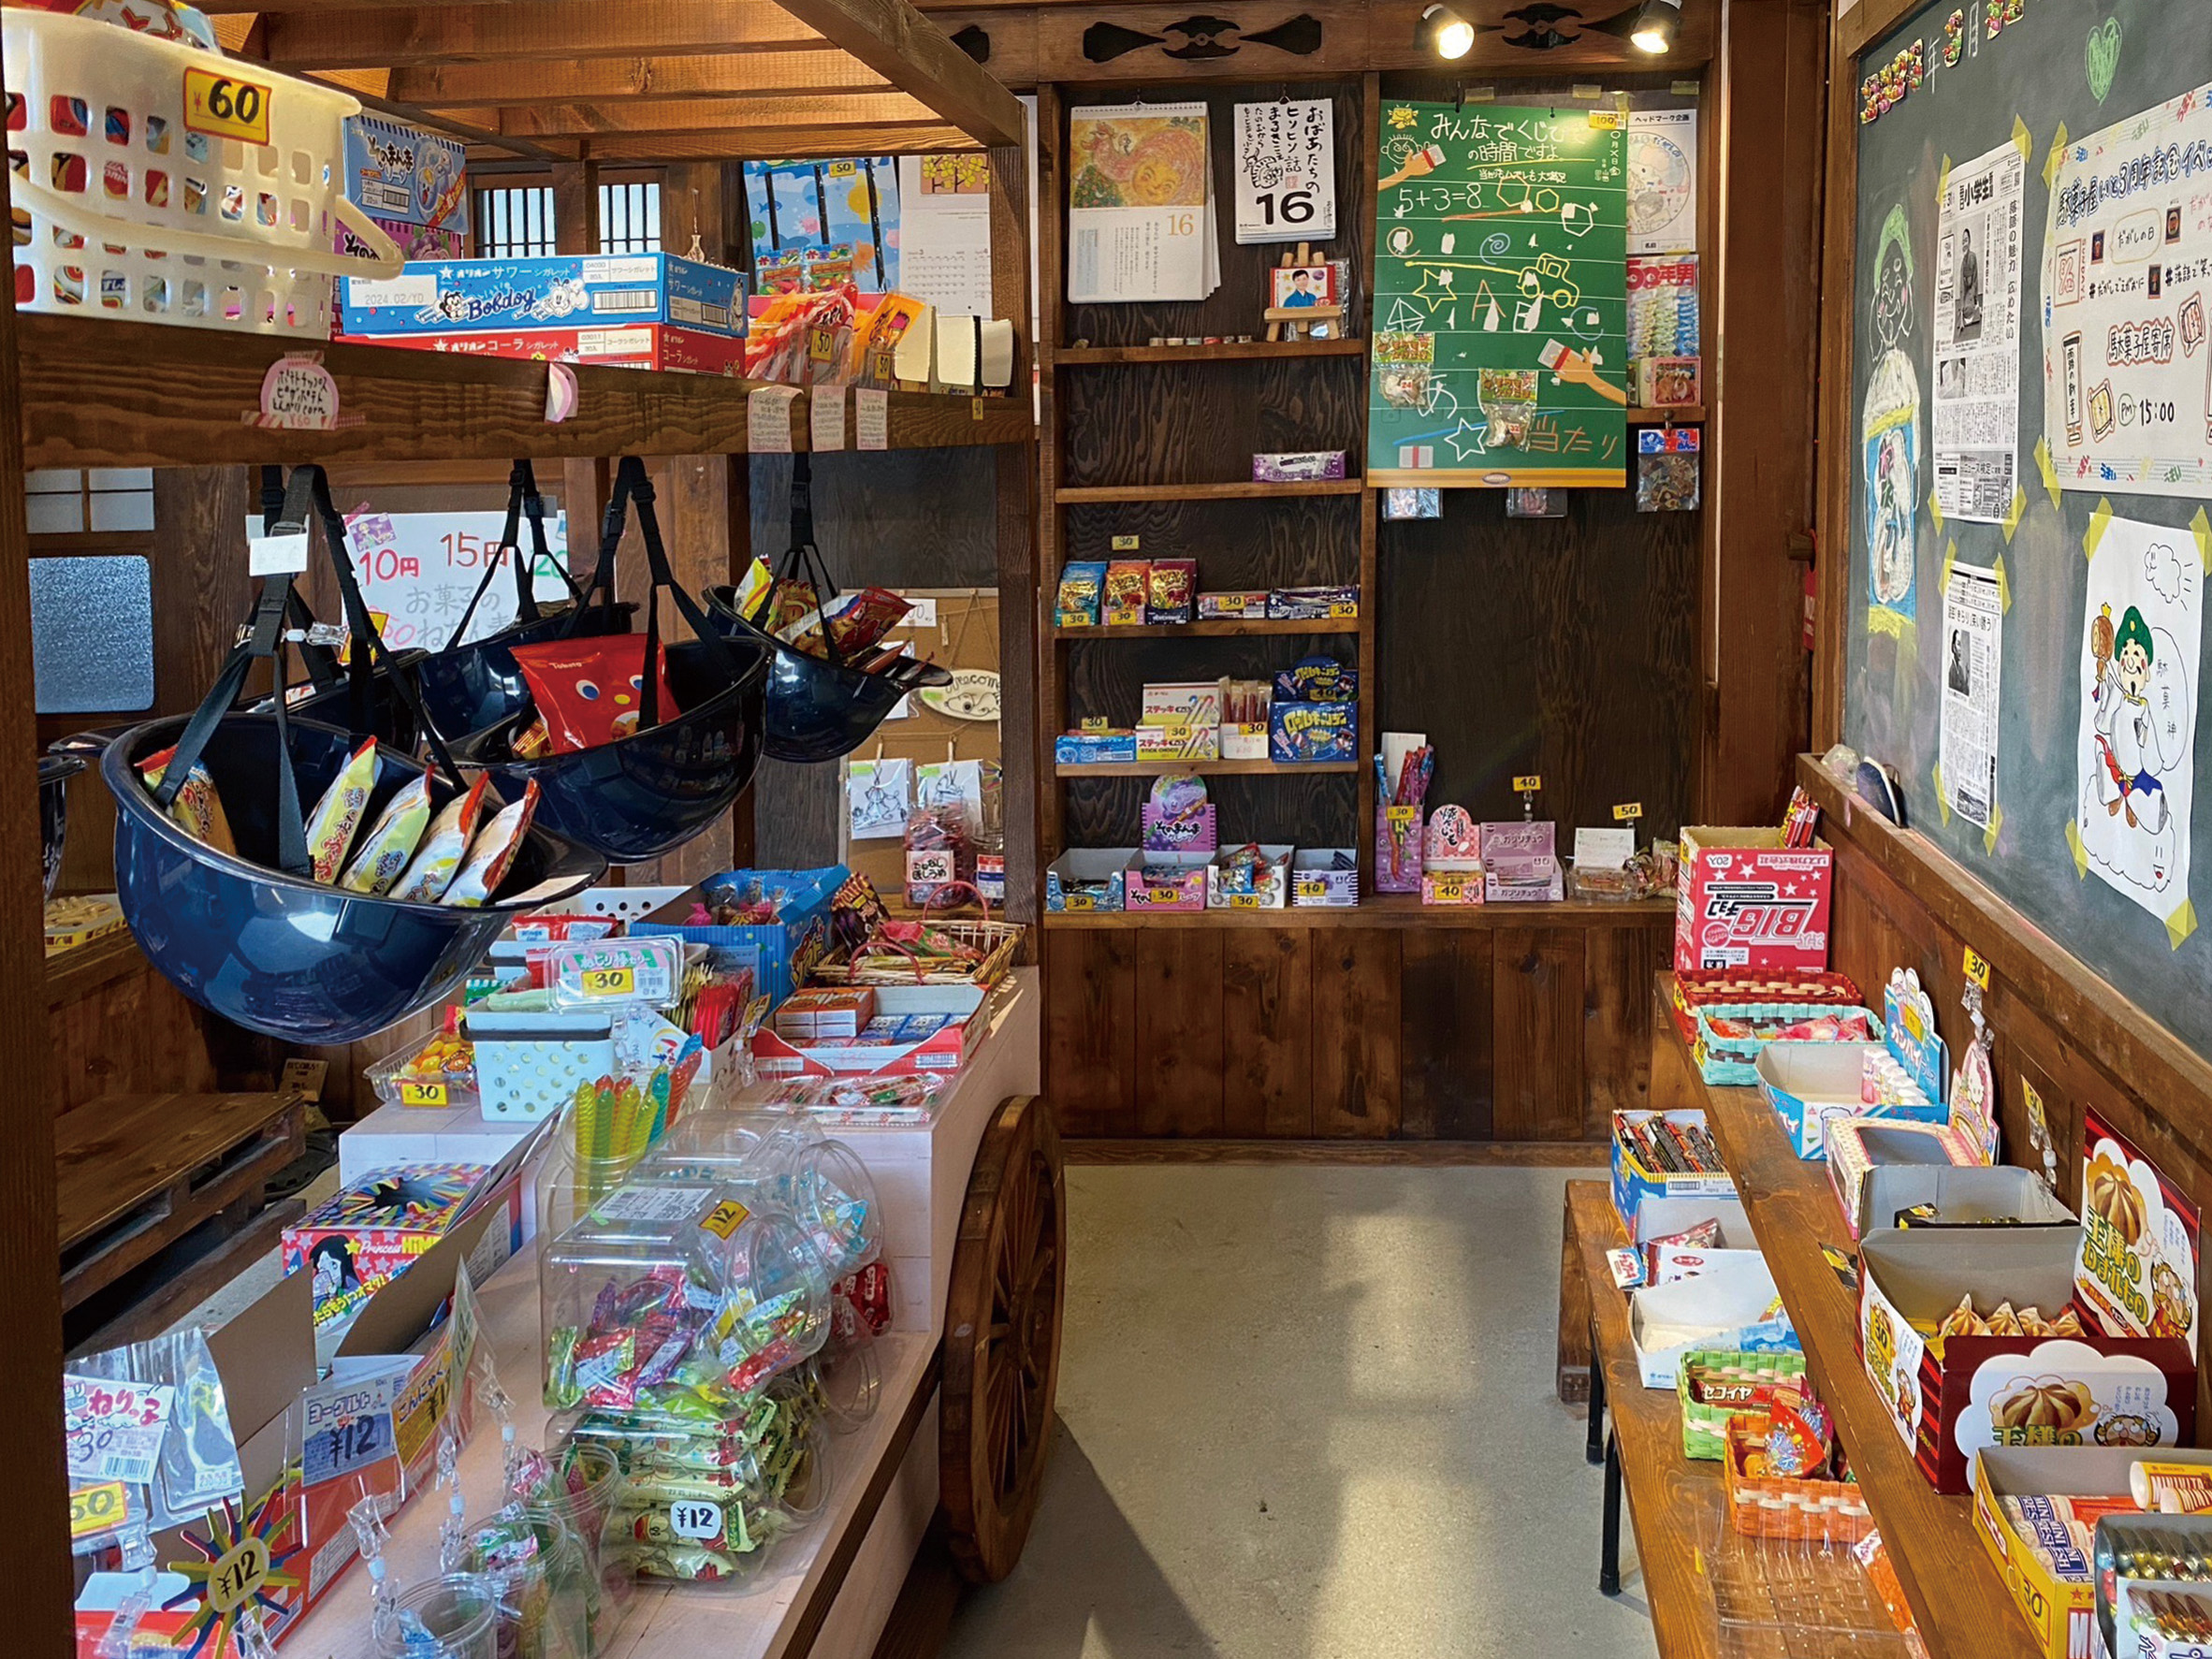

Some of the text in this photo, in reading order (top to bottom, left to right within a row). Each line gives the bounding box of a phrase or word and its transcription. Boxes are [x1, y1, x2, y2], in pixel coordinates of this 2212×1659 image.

[1468, 142, 1559, 163] の時間ですよ
[1256, 191, 1315, 225] 16
[1168, 214, 1194, 236] 16
[2117, 226, 2155, 249] だがしの日
[468, 288, 537, 321] Bobdog
[2140, 400, 2176, 426] 15:00
[359, 548, 420, 587] 10円
[1087, 717, 1103, 728] 30
[1247, 722, 1265, 735] 30
[1520, 778, 1537, 788] 40
[1621, 805, 1638, 816] 50
[1157, 890, 1174, 900] 30
[1237, 895, 1254, 906] 30
[1441, 886, 1460, 896] 40
[1707, 900, 1740, 917] チョコ
[1729, 906, 1812, 939] BIG
[1970, 954, 1986, 980] 30
[594, 972, 624, 989] 30
[414, 1084, 440, 1101] 30
[359, 1239, 402, 1254] Princess
[2086, 1204, 2143, 1285] 王様の
[1874, 1317, 1888, 1349] 30
[1701, 1384, 1754, 1403] セコイヤ
[89, 1388, 161, 1427] ねりっ子
[308, 1390, 371, 1426] ヨーグルト
[330, 1414, 377, 1468] ¥12
[677, 1507, 714, 1529] ¥12
[216, 1549, 259, 1598] ¥12
[2022, 1578, 2043, 1619] 30
